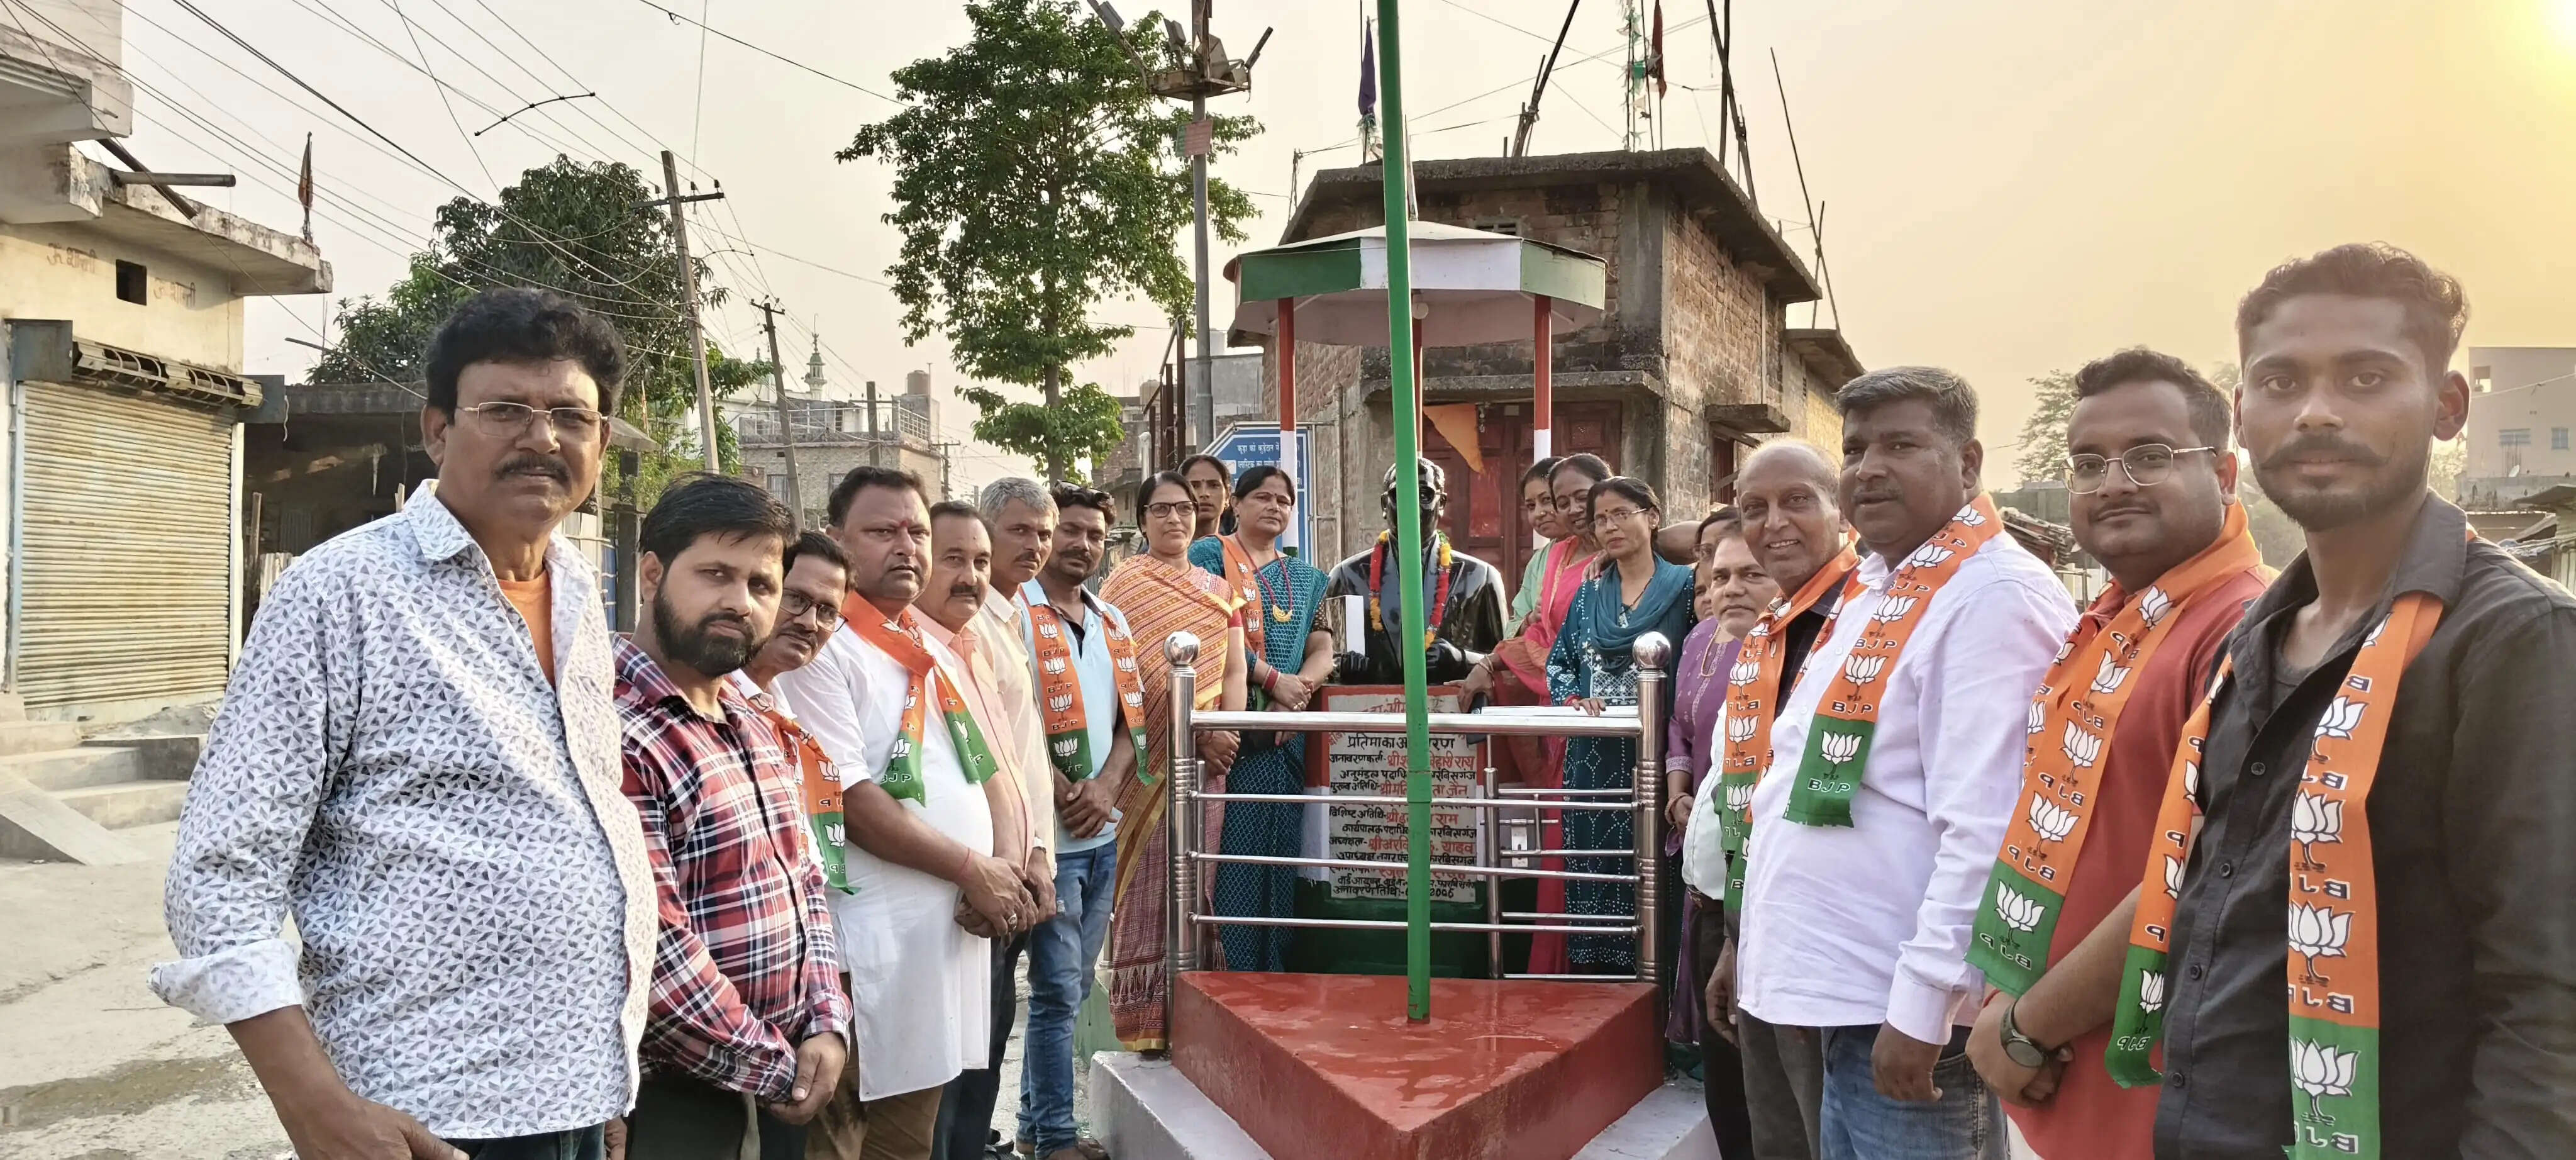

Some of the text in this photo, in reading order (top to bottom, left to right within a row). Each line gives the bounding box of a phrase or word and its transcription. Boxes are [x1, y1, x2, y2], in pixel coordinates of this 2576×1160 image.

[1855, 637, 1897, 650] BJP
[1047, 681, 1073, 694] BJP
[1831, 700, 1873, 715] BJP
[1052, 718, 1079, 732] BJP
[1807, 778, 1851, 793] BJP
